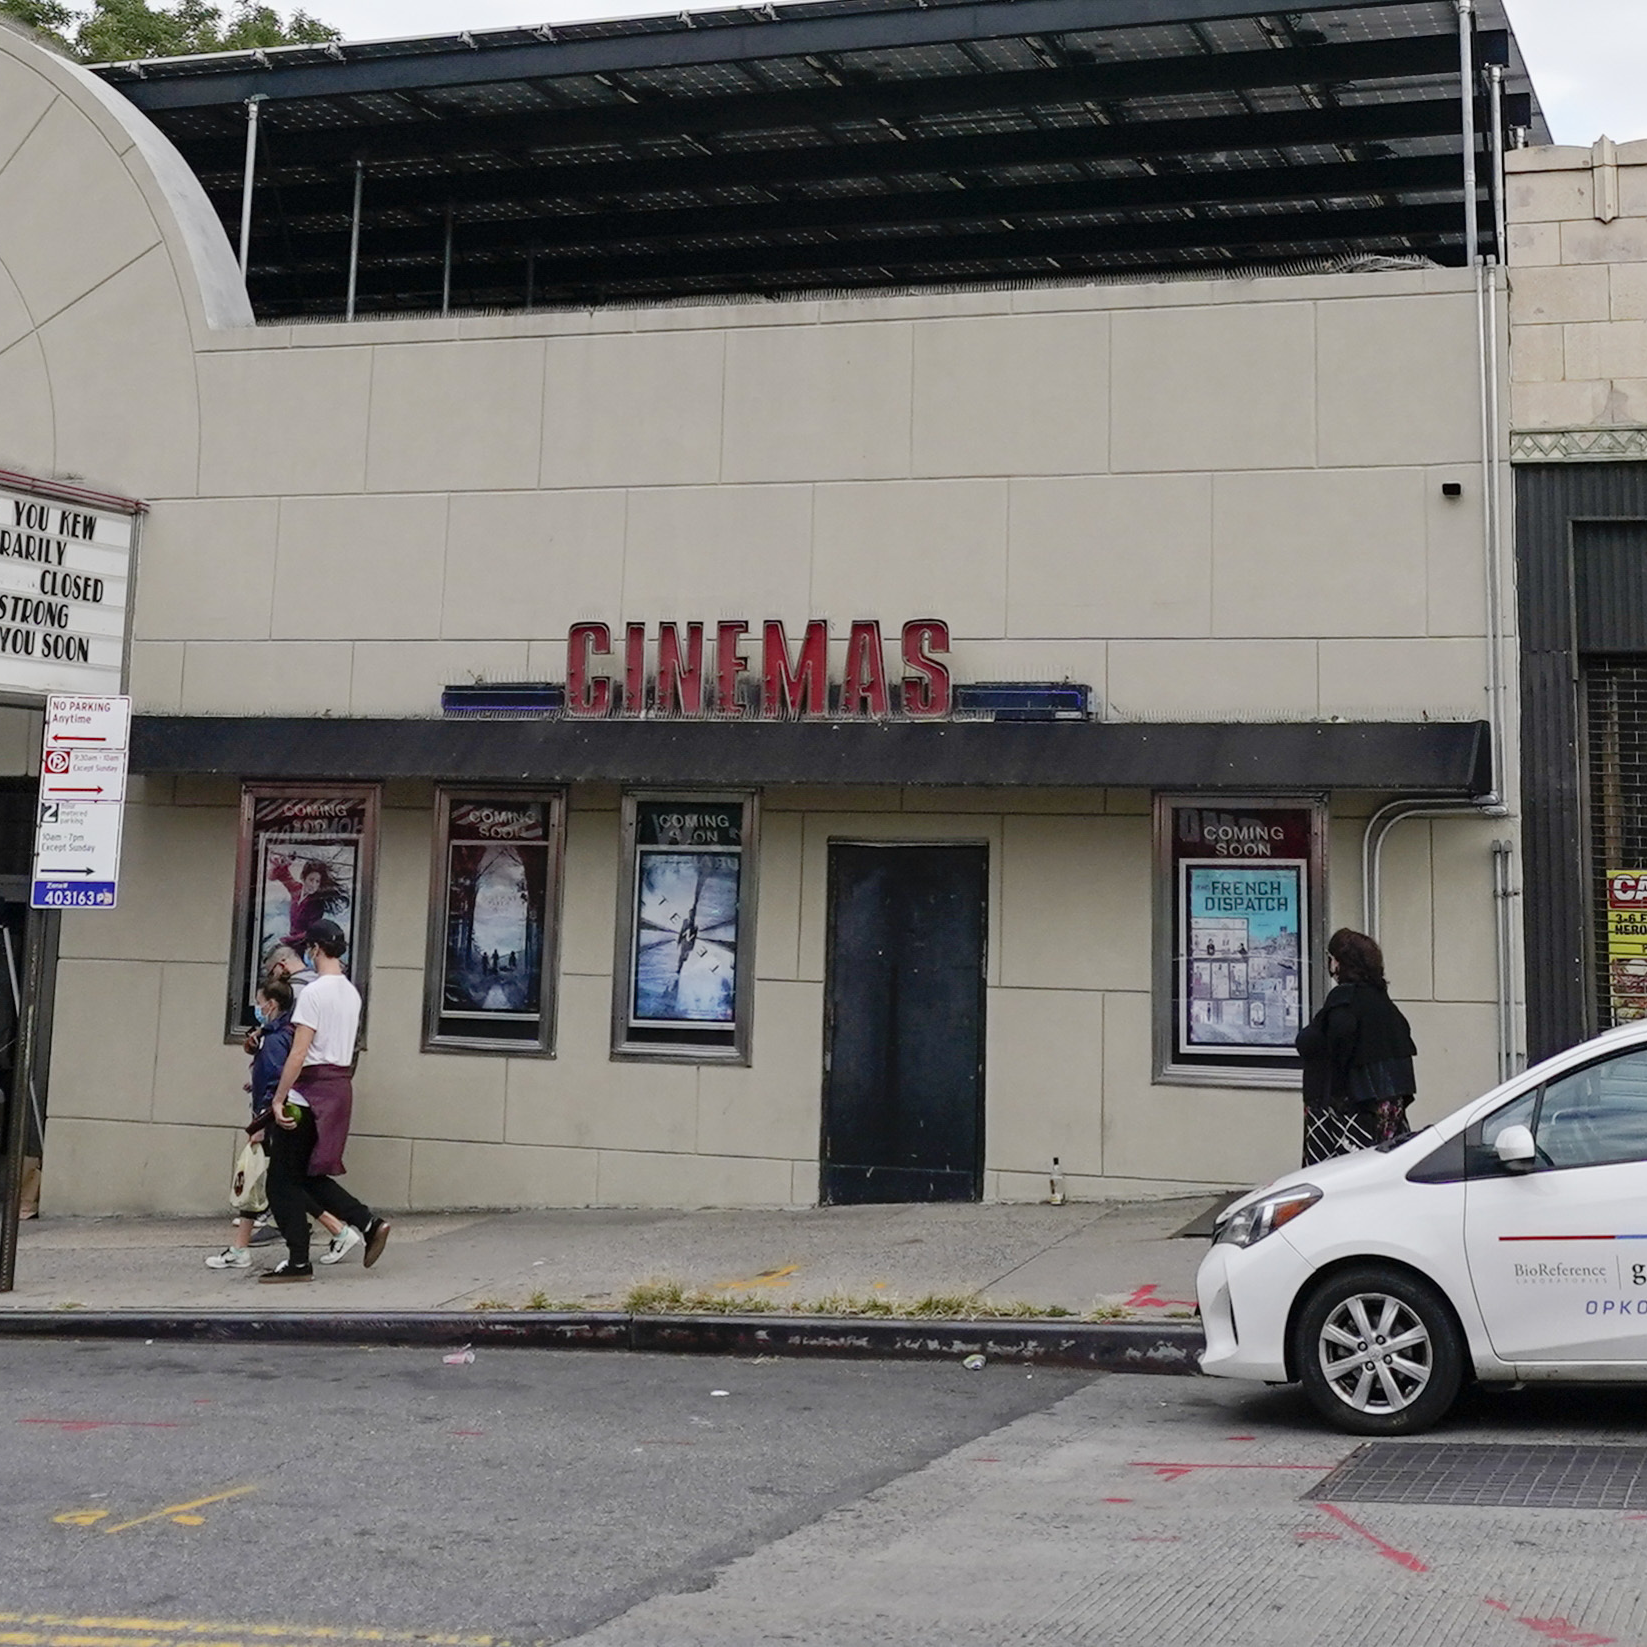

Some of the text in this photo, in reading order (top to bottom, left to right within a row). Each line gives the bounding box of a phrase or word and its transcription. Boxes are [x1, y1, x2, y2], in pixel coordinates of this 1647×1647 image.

[14, 500, 49, 531] YOU
[59, 510, 97, 540] KEW
[40, 570, 103, 603] CLOSED
[0, 626, 36, 655] YOU
[42, 633, 90, 663] SOON
[566, 619, 952, 718] CINEMAS
[53, 701, 111, 712] NO PARKING
[53, 714, 91, 725] Anytime
[283, 804, 347, 816] COMING
[469, 811, 535, 823] COMING
[659, 814, 729, 828] COMING
[669, 830, 719, 843] SON
[1203, 826, 1284, 840] COMING
[1215, 843, 1272, 856] SOON
[1211, 881, 1281, 896] FRENCH
[44, 890, 95, 906] 403163
[1205, 897, 1288, 912] DISPATCH
[1514, 1262, 1607, 1277] BioReference
